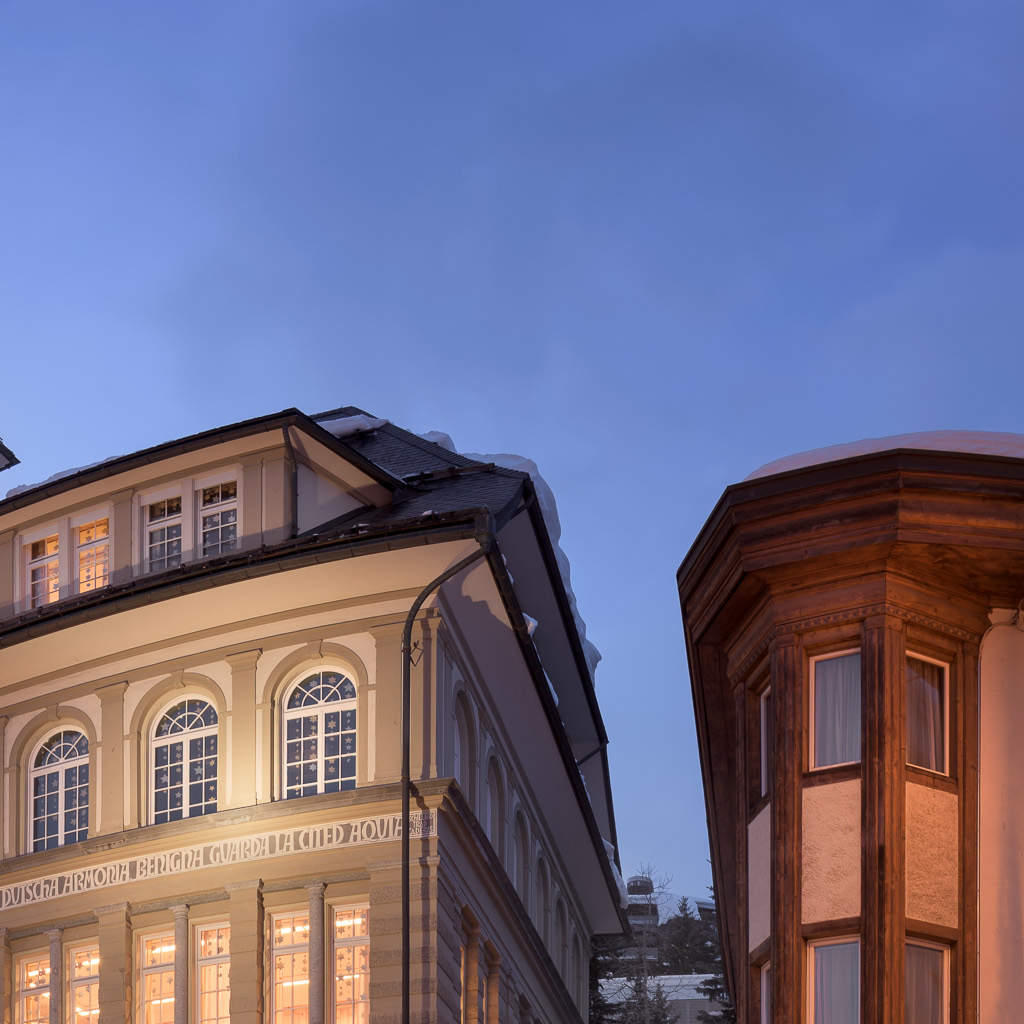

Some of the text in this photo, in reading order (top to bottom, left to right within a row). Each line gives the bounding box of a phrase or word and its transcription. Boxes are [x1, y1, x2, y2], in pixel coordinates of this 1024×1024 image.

[136, 849, 204, 878] BENIGNA
[209, 835, 269, 865] GUARDA
[275, 831, 294, 853] LA
[298, 825, 344, 850] CITED
